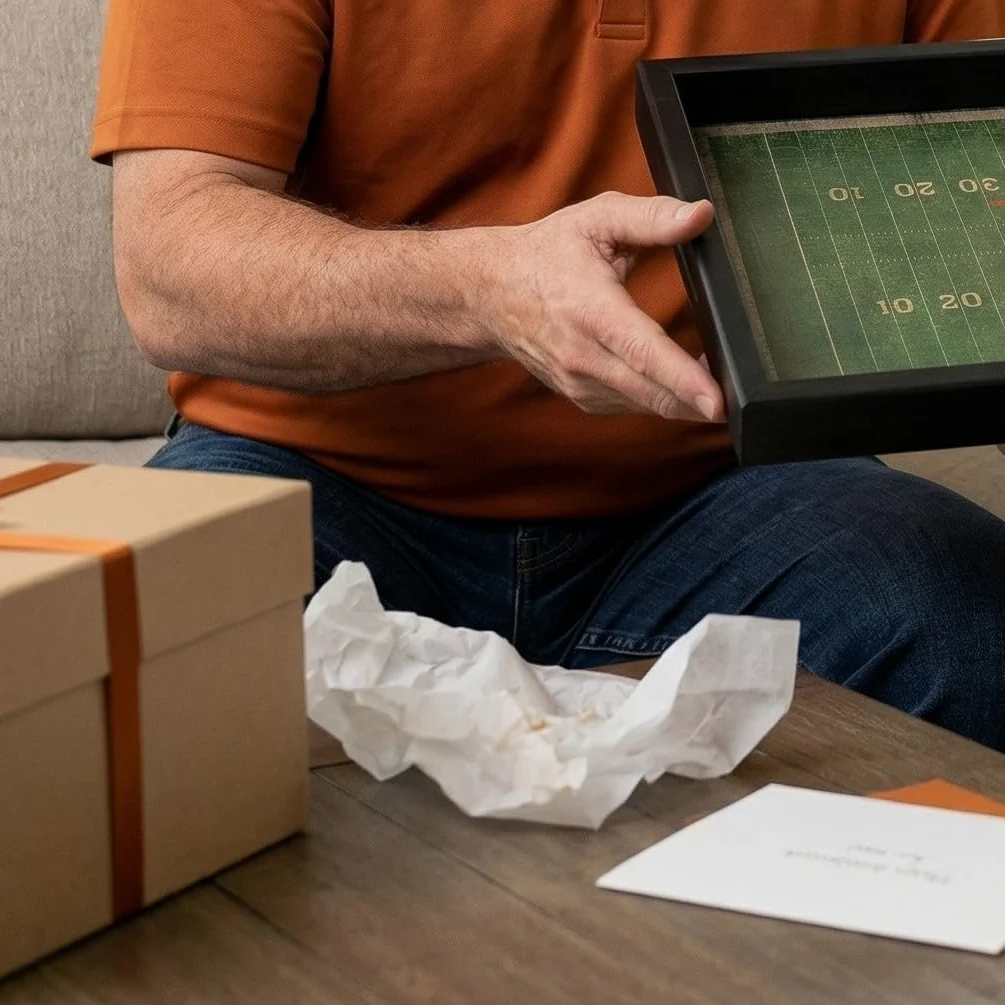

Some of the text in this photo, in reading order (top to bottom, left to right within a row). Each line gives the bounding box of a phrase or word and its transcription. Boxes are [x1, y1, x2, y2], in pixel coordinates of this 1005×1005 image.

[828, 186, 865, 201] 10
[894, 181, 936, 197] 20
[958, 177, 1000, 193] 30
[876, 297, 914, 315] 10
[939, 292, 982, 310] 20
